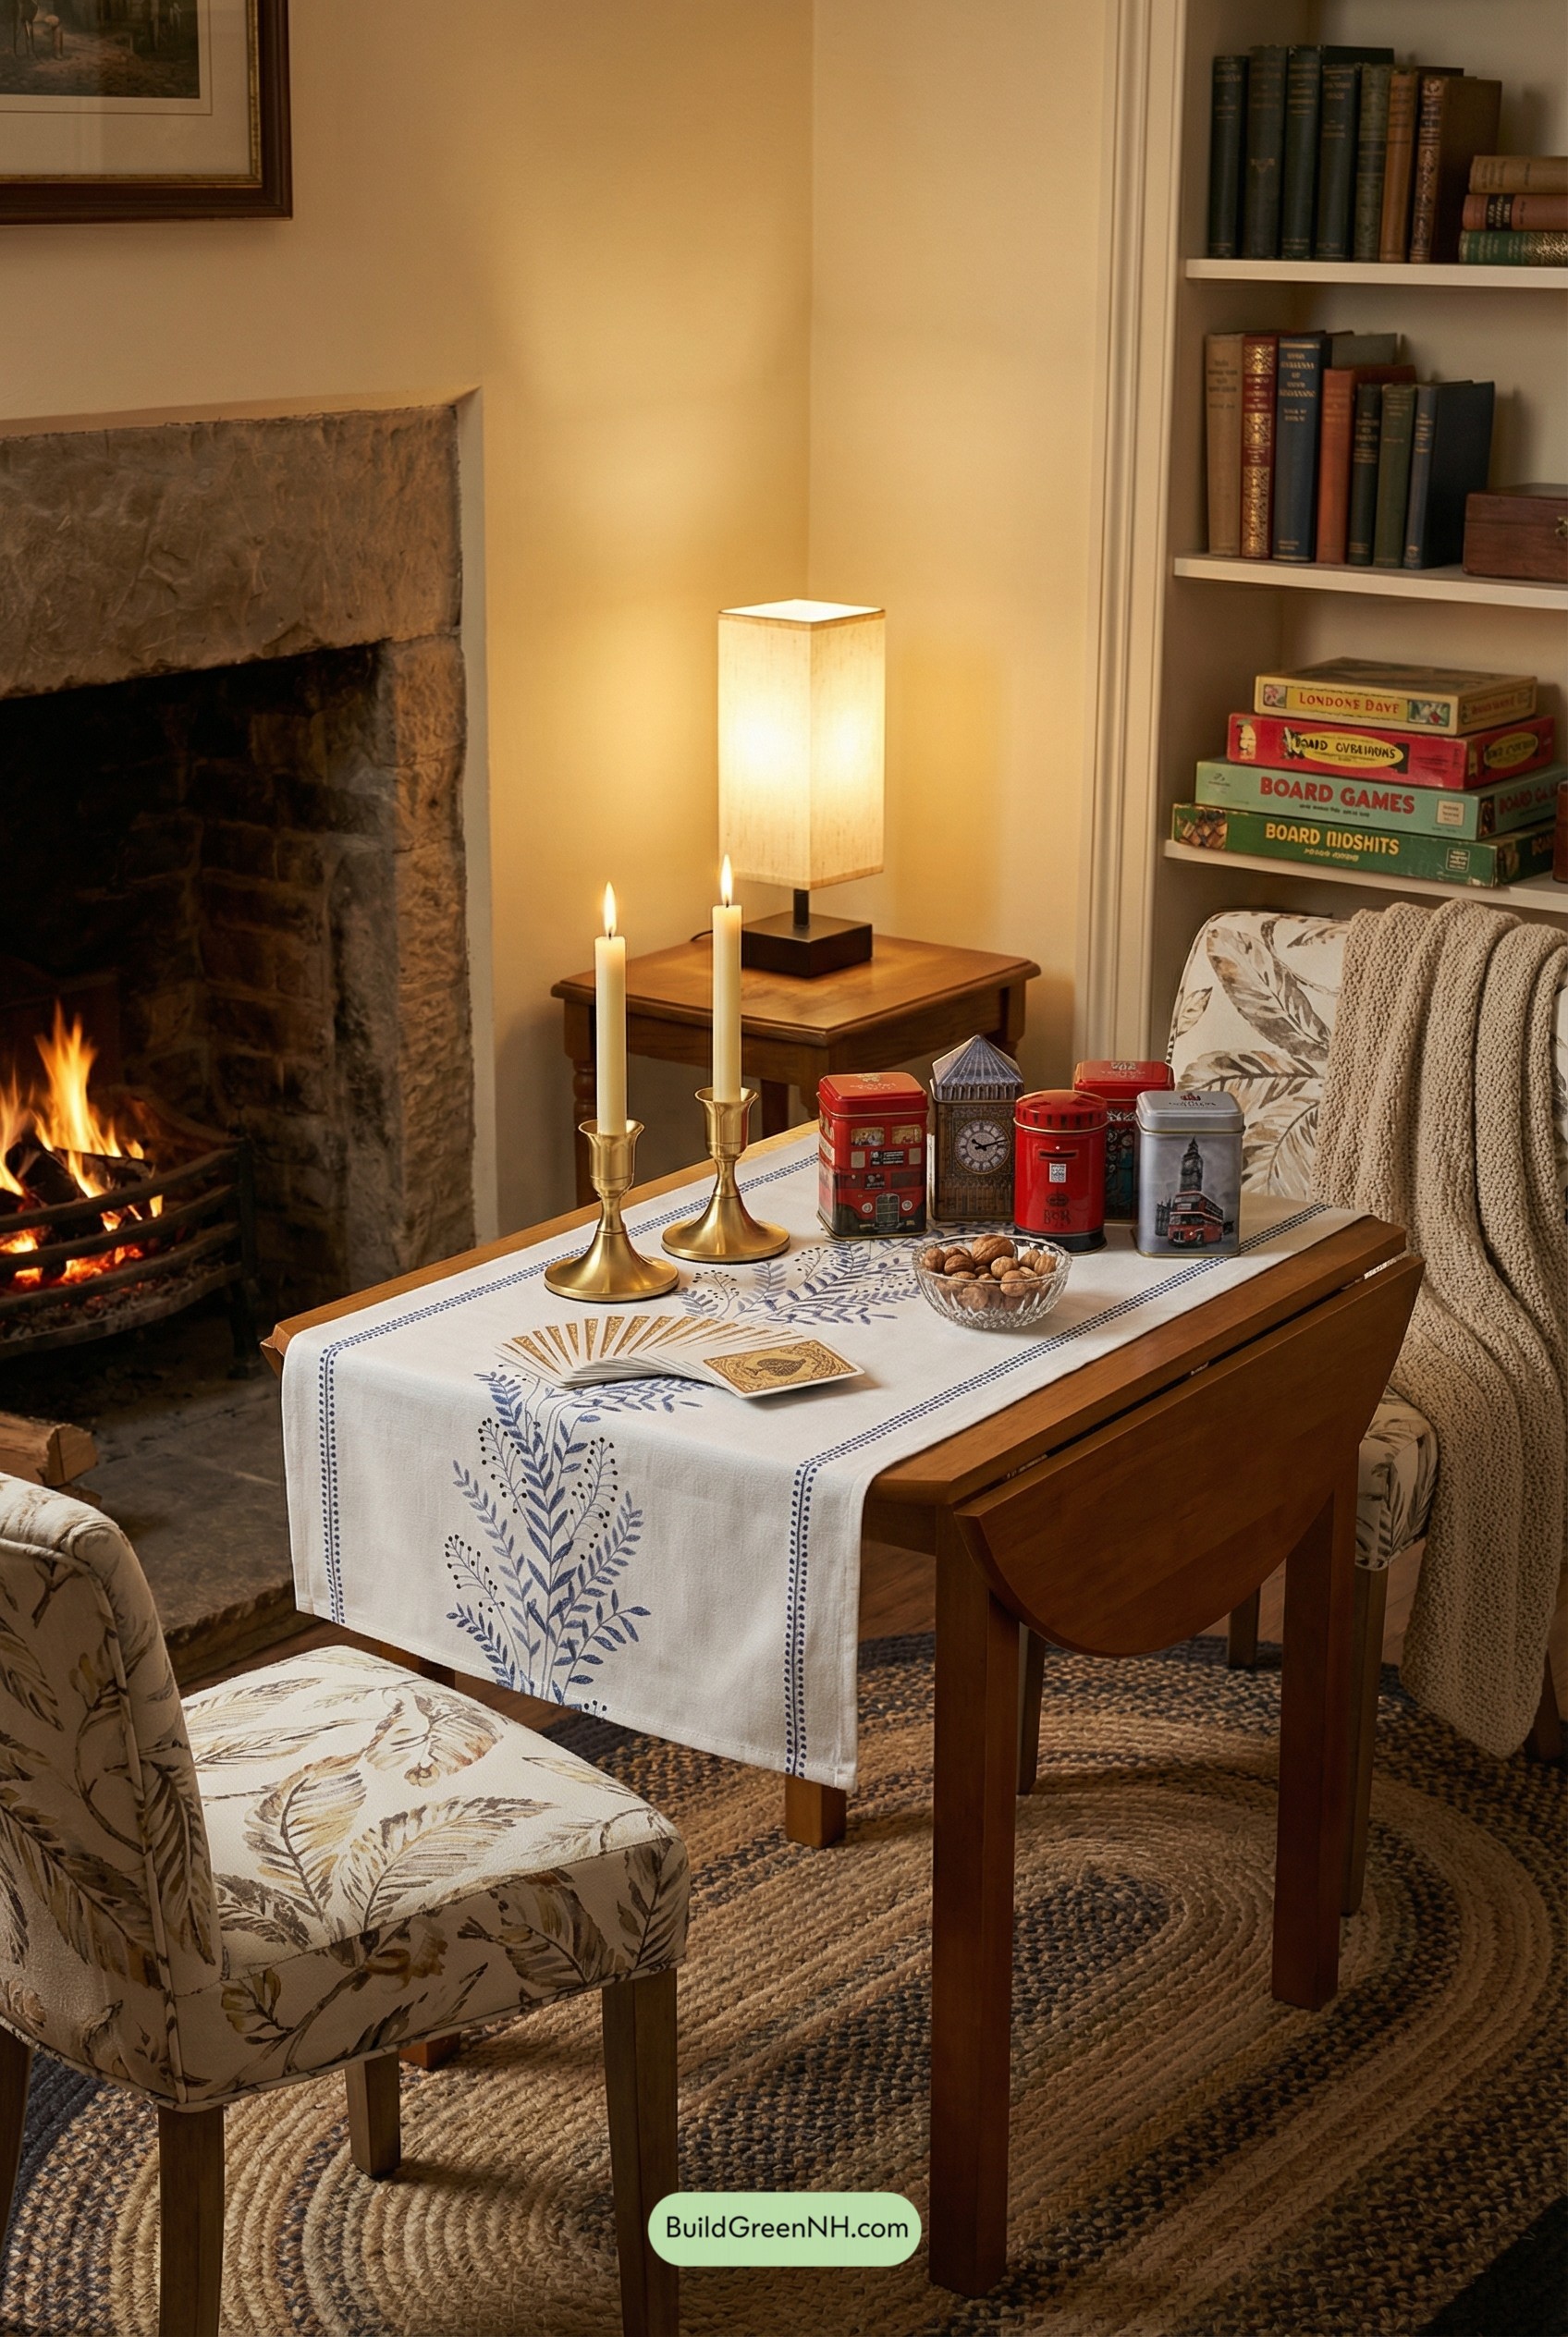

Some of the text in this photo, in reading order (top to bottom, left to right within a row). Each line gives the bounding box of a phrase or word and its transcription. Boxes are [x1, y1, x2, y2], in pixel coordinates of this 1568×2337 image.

[1260, 776, 1333, 802] BOARD
[1340, 787, 1415, 814] GAMES
[1265, 822, 1321, 846] BOARD
